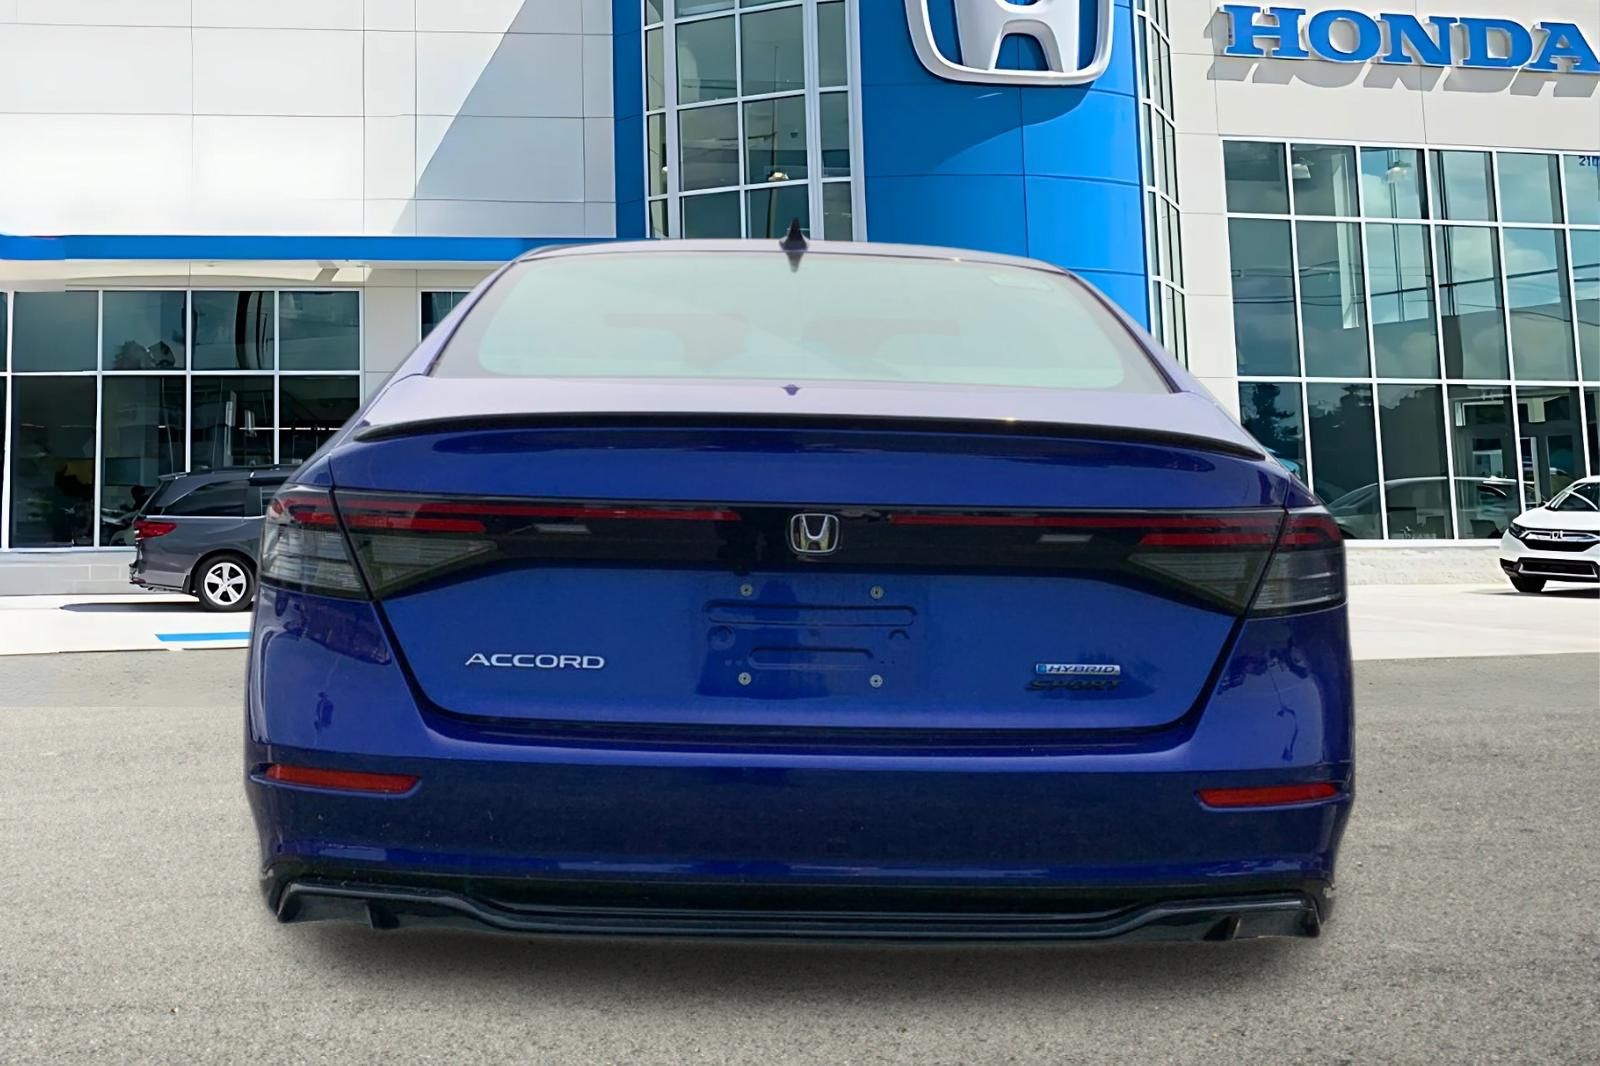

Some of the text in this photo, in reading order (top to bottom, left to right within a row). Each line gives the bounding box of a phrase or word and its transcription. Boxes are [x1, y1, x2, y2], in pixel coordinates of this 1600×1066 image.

[1222, 4, 1600, 72] HONDA
[465, 653, 605, 669] ACCORD
[1047, 665, 1117, 674] HYBRID
